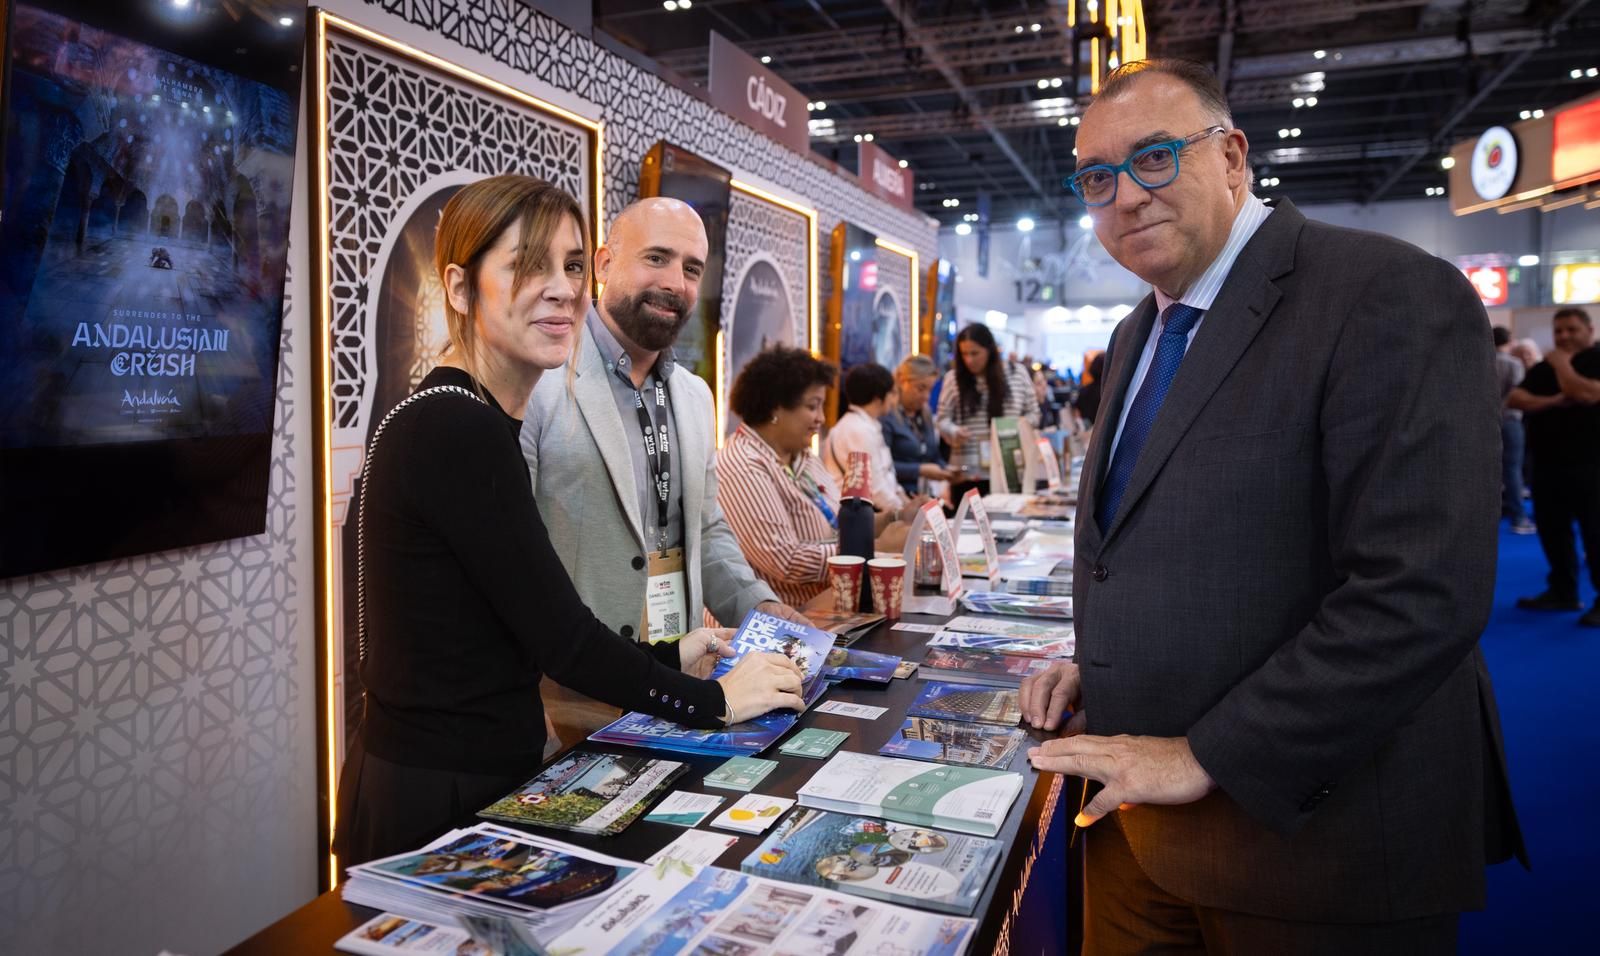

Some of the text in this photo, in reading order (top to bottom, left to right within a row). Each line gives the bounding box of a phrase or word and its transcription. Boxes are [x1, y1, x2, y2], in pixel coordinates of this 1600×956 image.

[747, 75, 787, 128] CÁDIZ
[1014, 279, 1041, 303] 12
[113, 309, 201, 322] SURRENDER TO THE
[71, 322, 230, 353] ANDALUSIAN
[658, 388, 666, 407] wtm
[648, 435, 656, 455] wtm
[661, 481, 669, 501] wtm
[747, 617, 778, 638] DE
[753, 611, 809, 636] MOTRIL
